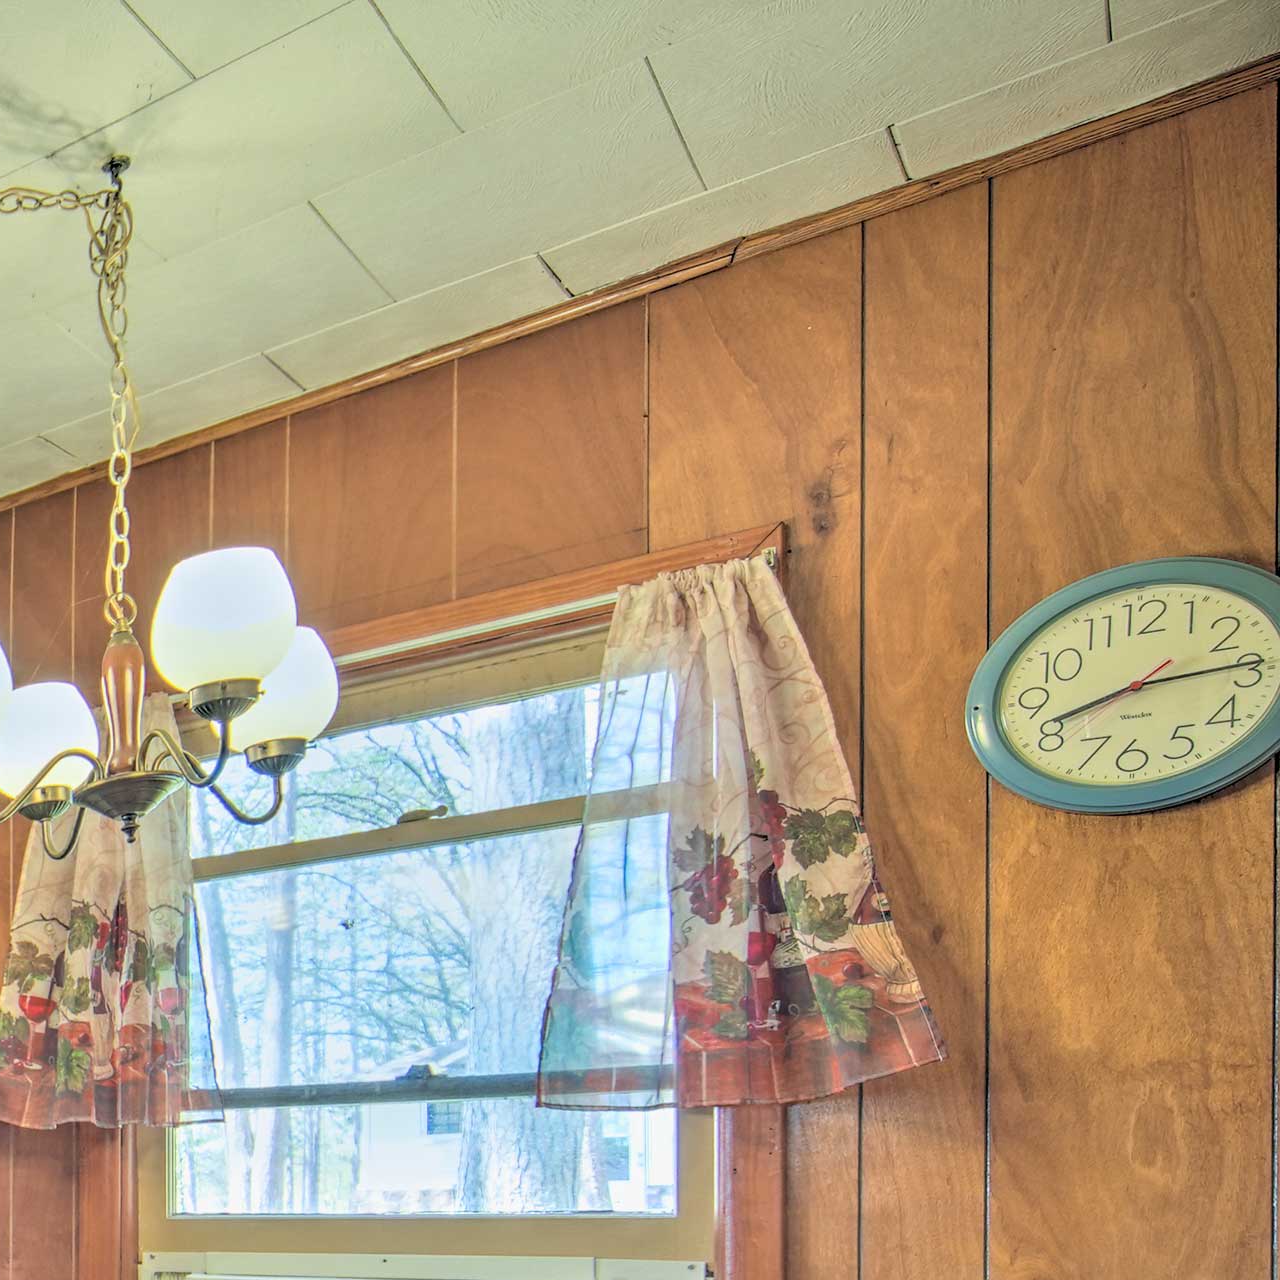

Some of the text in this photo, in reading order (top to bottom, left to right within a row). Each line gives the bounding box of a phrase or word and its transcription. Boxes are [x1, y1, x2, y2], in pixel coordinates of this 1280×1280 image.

[1083, 615, 1112, 651] 11
[1122, 599, 1167, 637] 12
[1183, 600, 1195, 634] 1
[1209, 616, 1241, 653] 2
[1040, 648, 1082, 684] 10
[1233, 653, 1263, 688] 3
[1018, 687, 1049, 719] 9
[1205, 693, 1242, 728] 4
[1038, 719, 1064, 752] 8
[1078, 735, 1112, 770] 7
[1163, 724, 1195, 760] 5
[1115, 738, 1149, 773] 6
